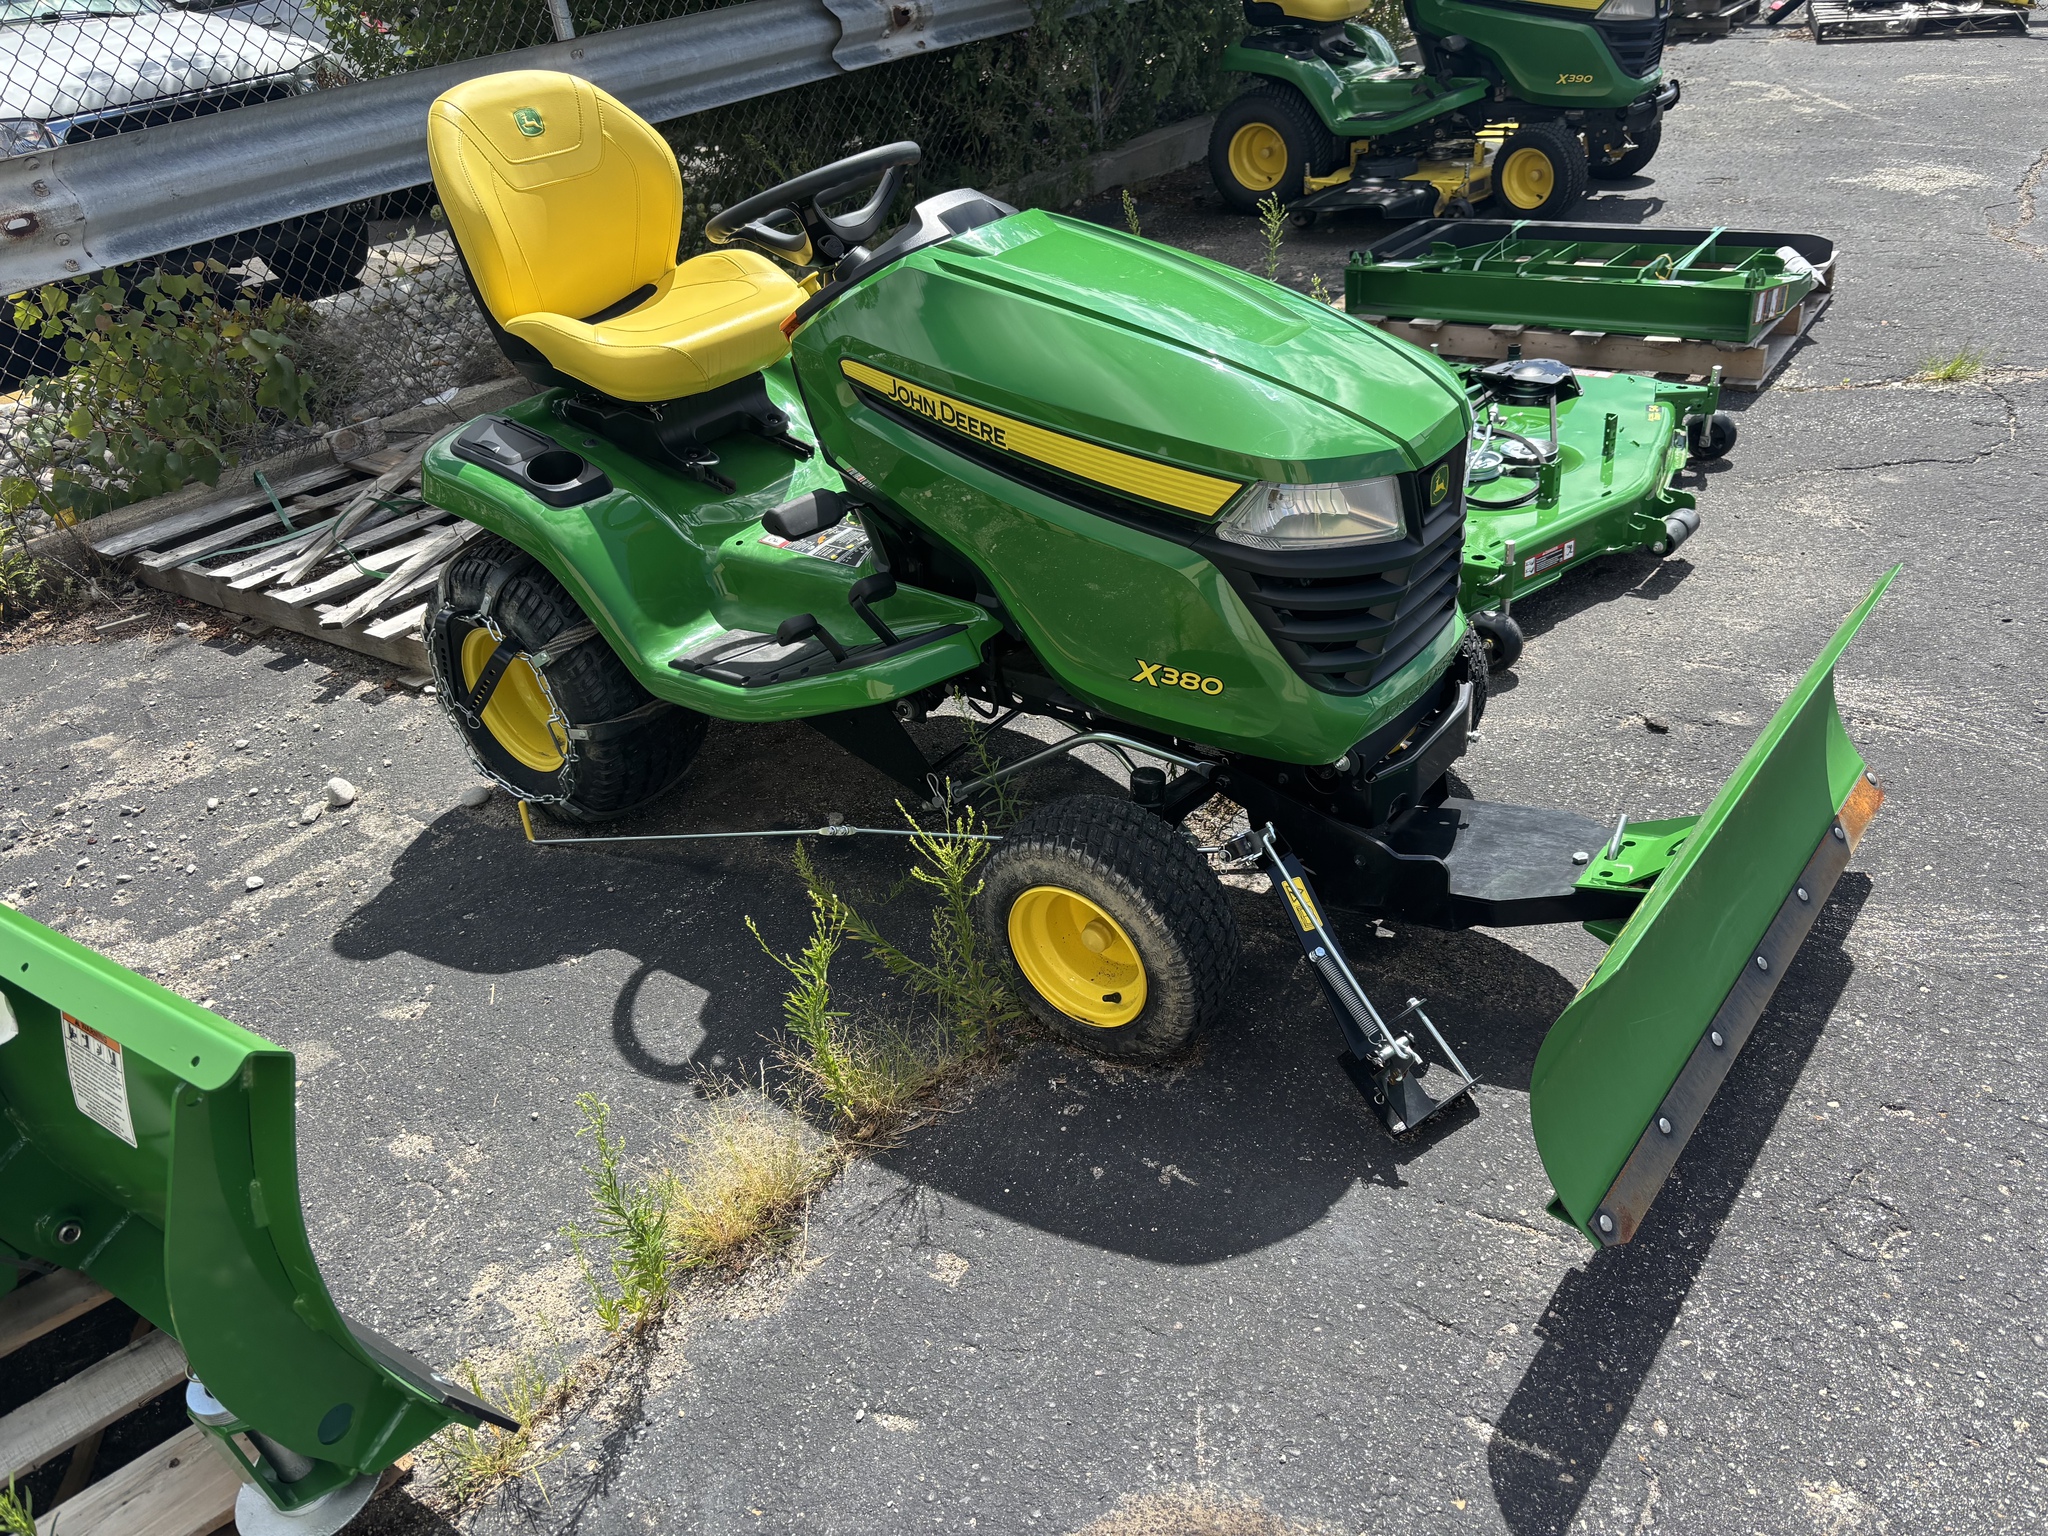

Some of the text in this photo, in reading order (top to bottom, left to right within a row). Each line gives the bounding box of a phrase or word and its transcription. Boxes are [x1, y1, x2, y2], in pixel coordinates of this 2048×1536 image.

[1555, 73, 1594, 85] X390
[888, 379, 1008, 449] JOHN DEERE
[1130, 658, 1224, 696] X380
